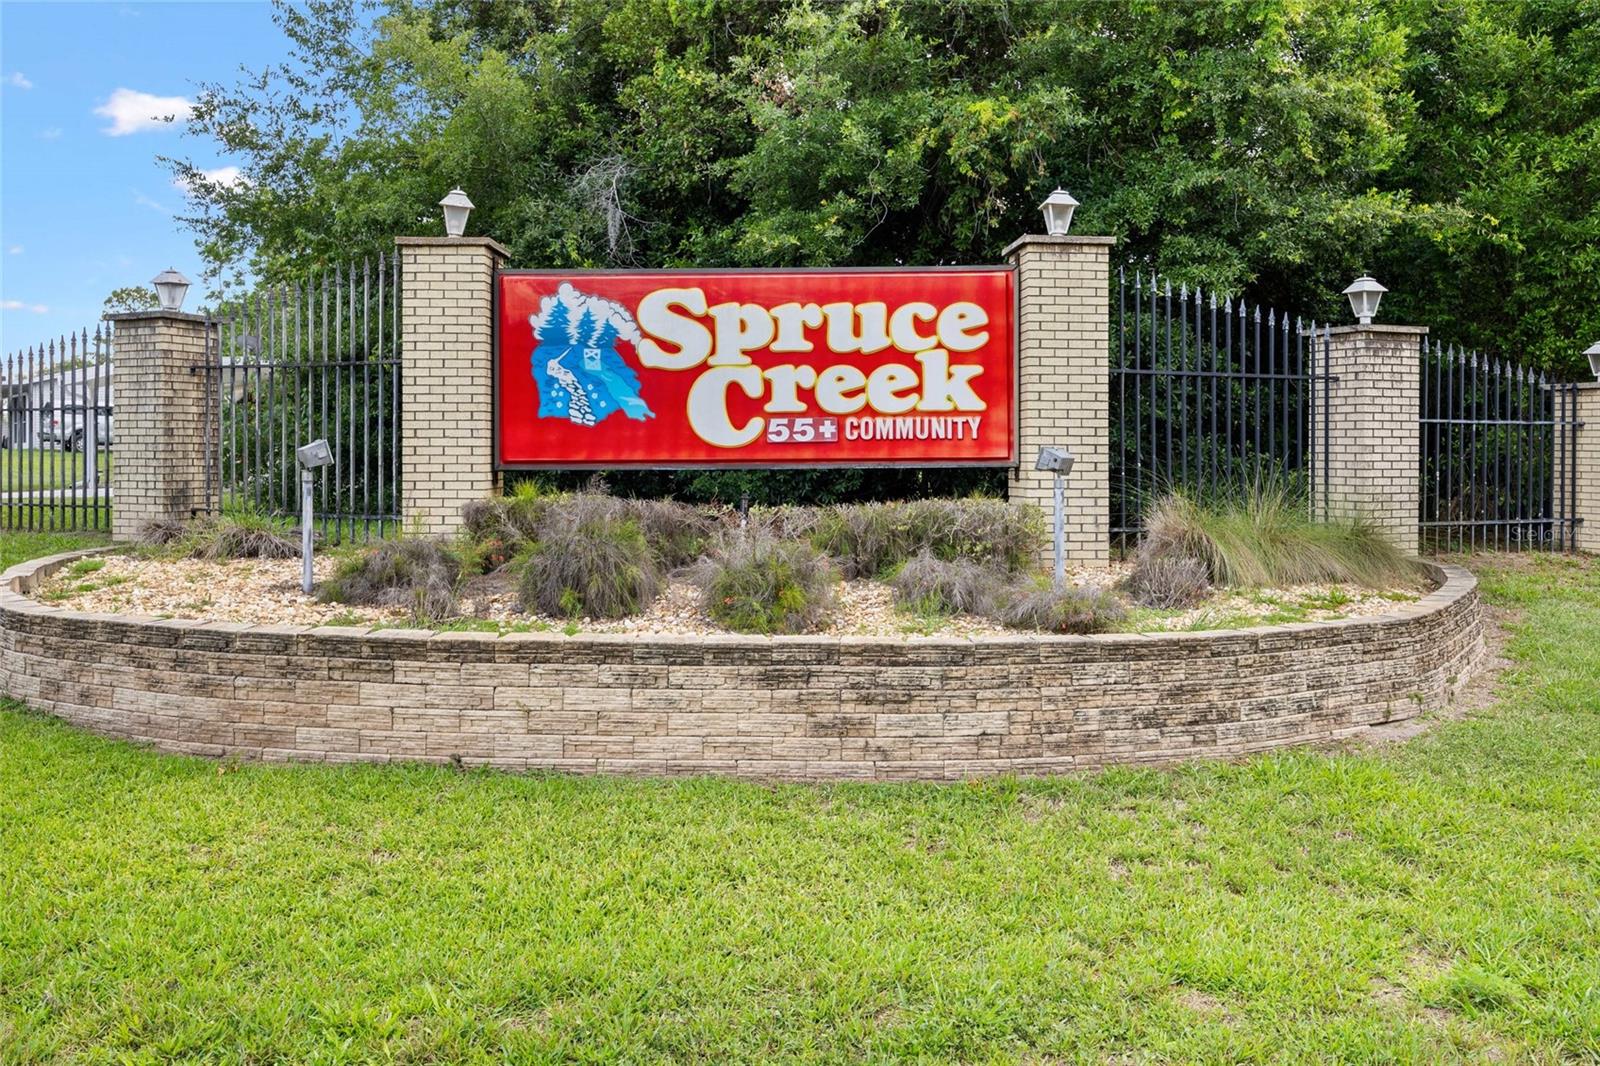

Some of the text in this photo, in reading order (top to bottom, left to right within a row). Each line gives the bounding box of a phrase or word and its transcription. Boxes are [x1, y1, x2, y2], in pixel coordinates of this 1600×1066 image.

[637, 287, 990, 370] Spruce
[686, 350, 987, 448] Creek
[767, 416, 983, 442] 55+ COMMUNITY
